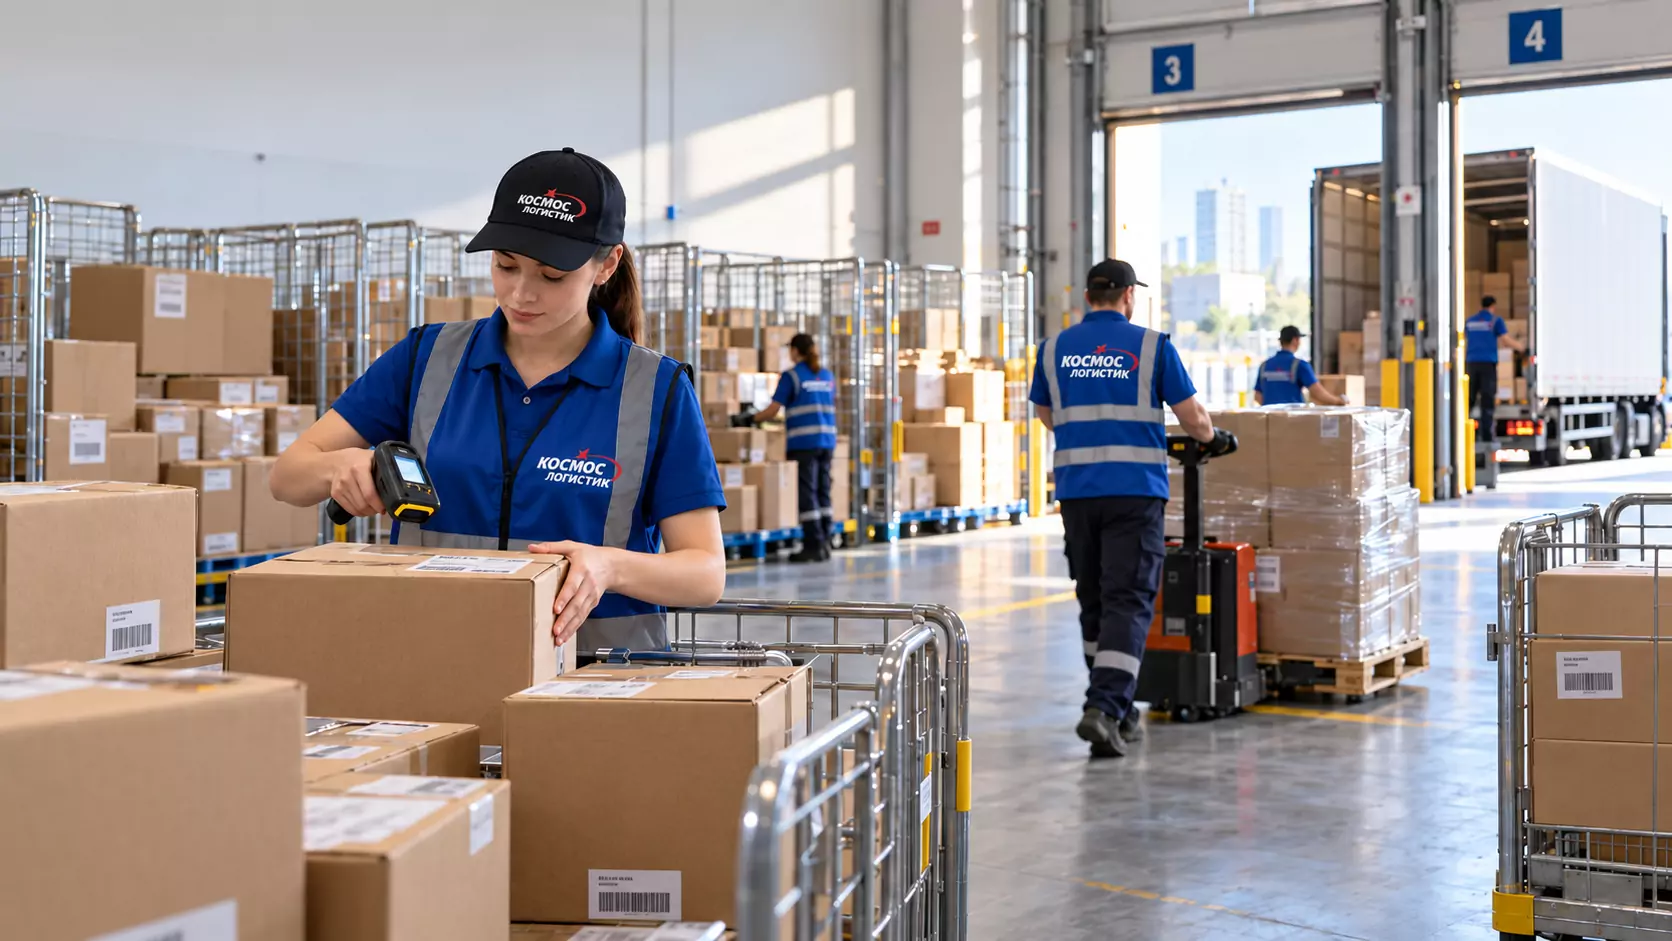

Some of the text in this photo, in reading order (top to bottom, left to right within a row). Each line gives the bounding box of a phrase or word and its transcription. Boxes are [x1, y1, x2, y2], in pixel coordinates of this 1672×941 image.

[1524, 19, 1547, 52] 4
[1164, 55, 1182, 86] 3
[518, 195, 571, 211] КОСМОС
[522, 206, 575, 222] ЛОГИСТИК
[1061, 355, 1123, 367] КОСМОС
[1070, 369, 1129, 379] ЛОГИСТИК
[537, 457, 606, 475] КОСМОС
[545, 472, 610, 488] ЛОГИСТИК
